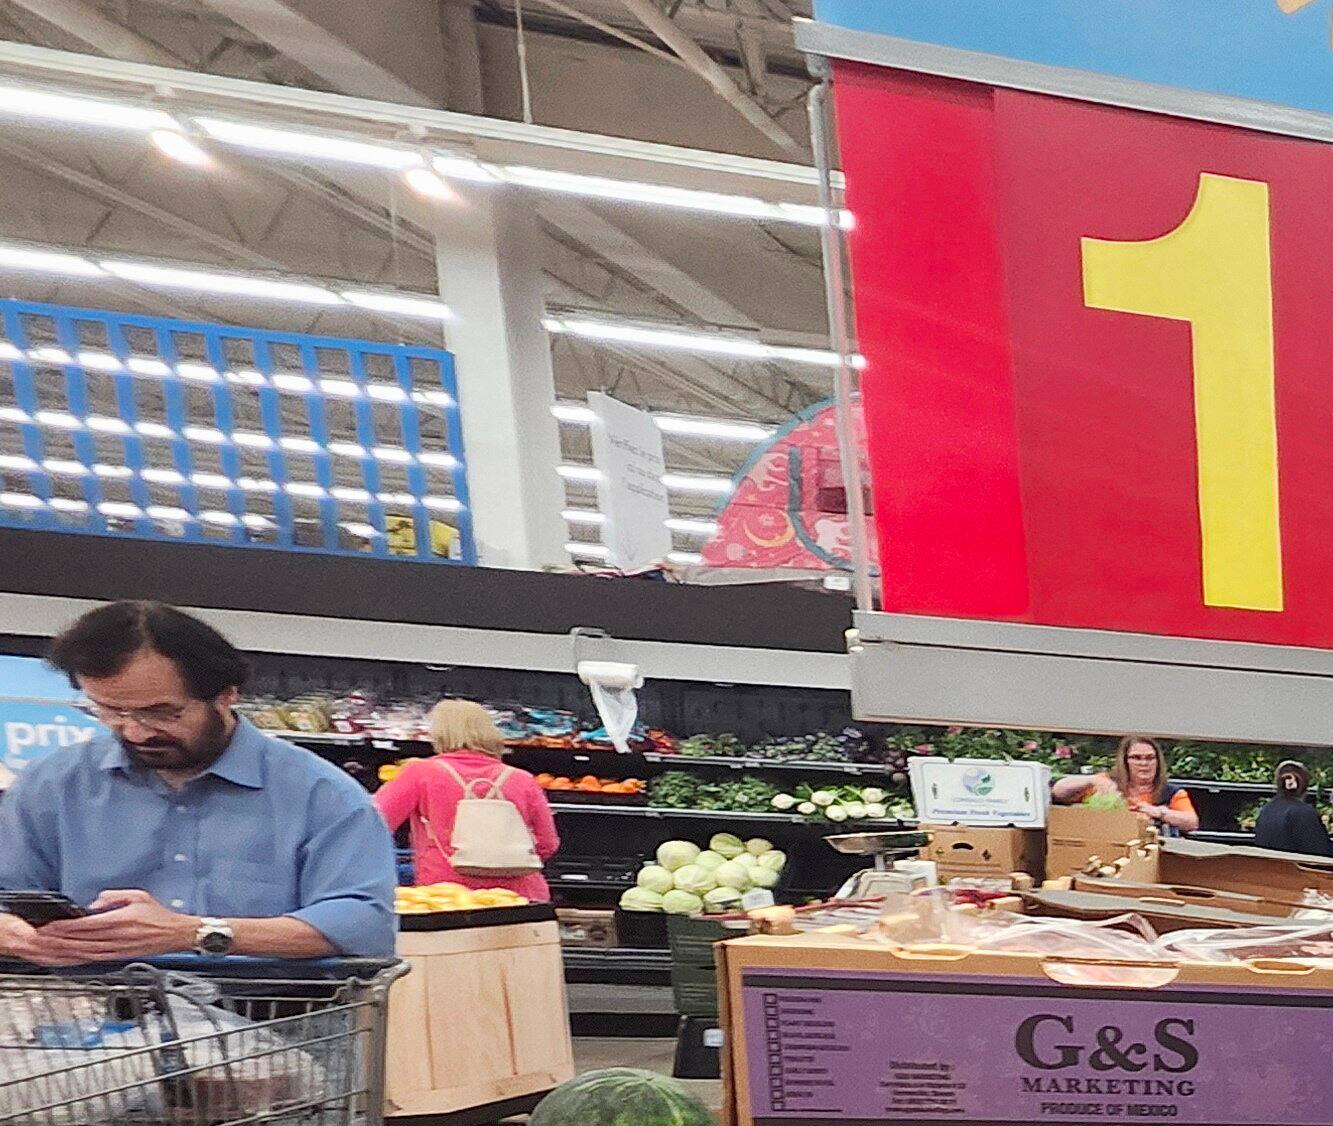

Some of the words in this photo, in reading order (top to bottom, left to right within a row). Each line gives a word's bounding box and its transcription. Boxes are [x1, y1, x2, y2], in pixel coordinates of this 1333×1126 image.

[1081, 172, 1284, 612] 1
[1015, 1014, 1199, 1073] G&S
[1020, 1077, 1195, 1097] MARKETING
[1041, 1102, 1103, 1116] PRODUCE
[1106, 1103, 1123, 1116] OF
[1127, 1104, 1178, 1117] MEXICO
